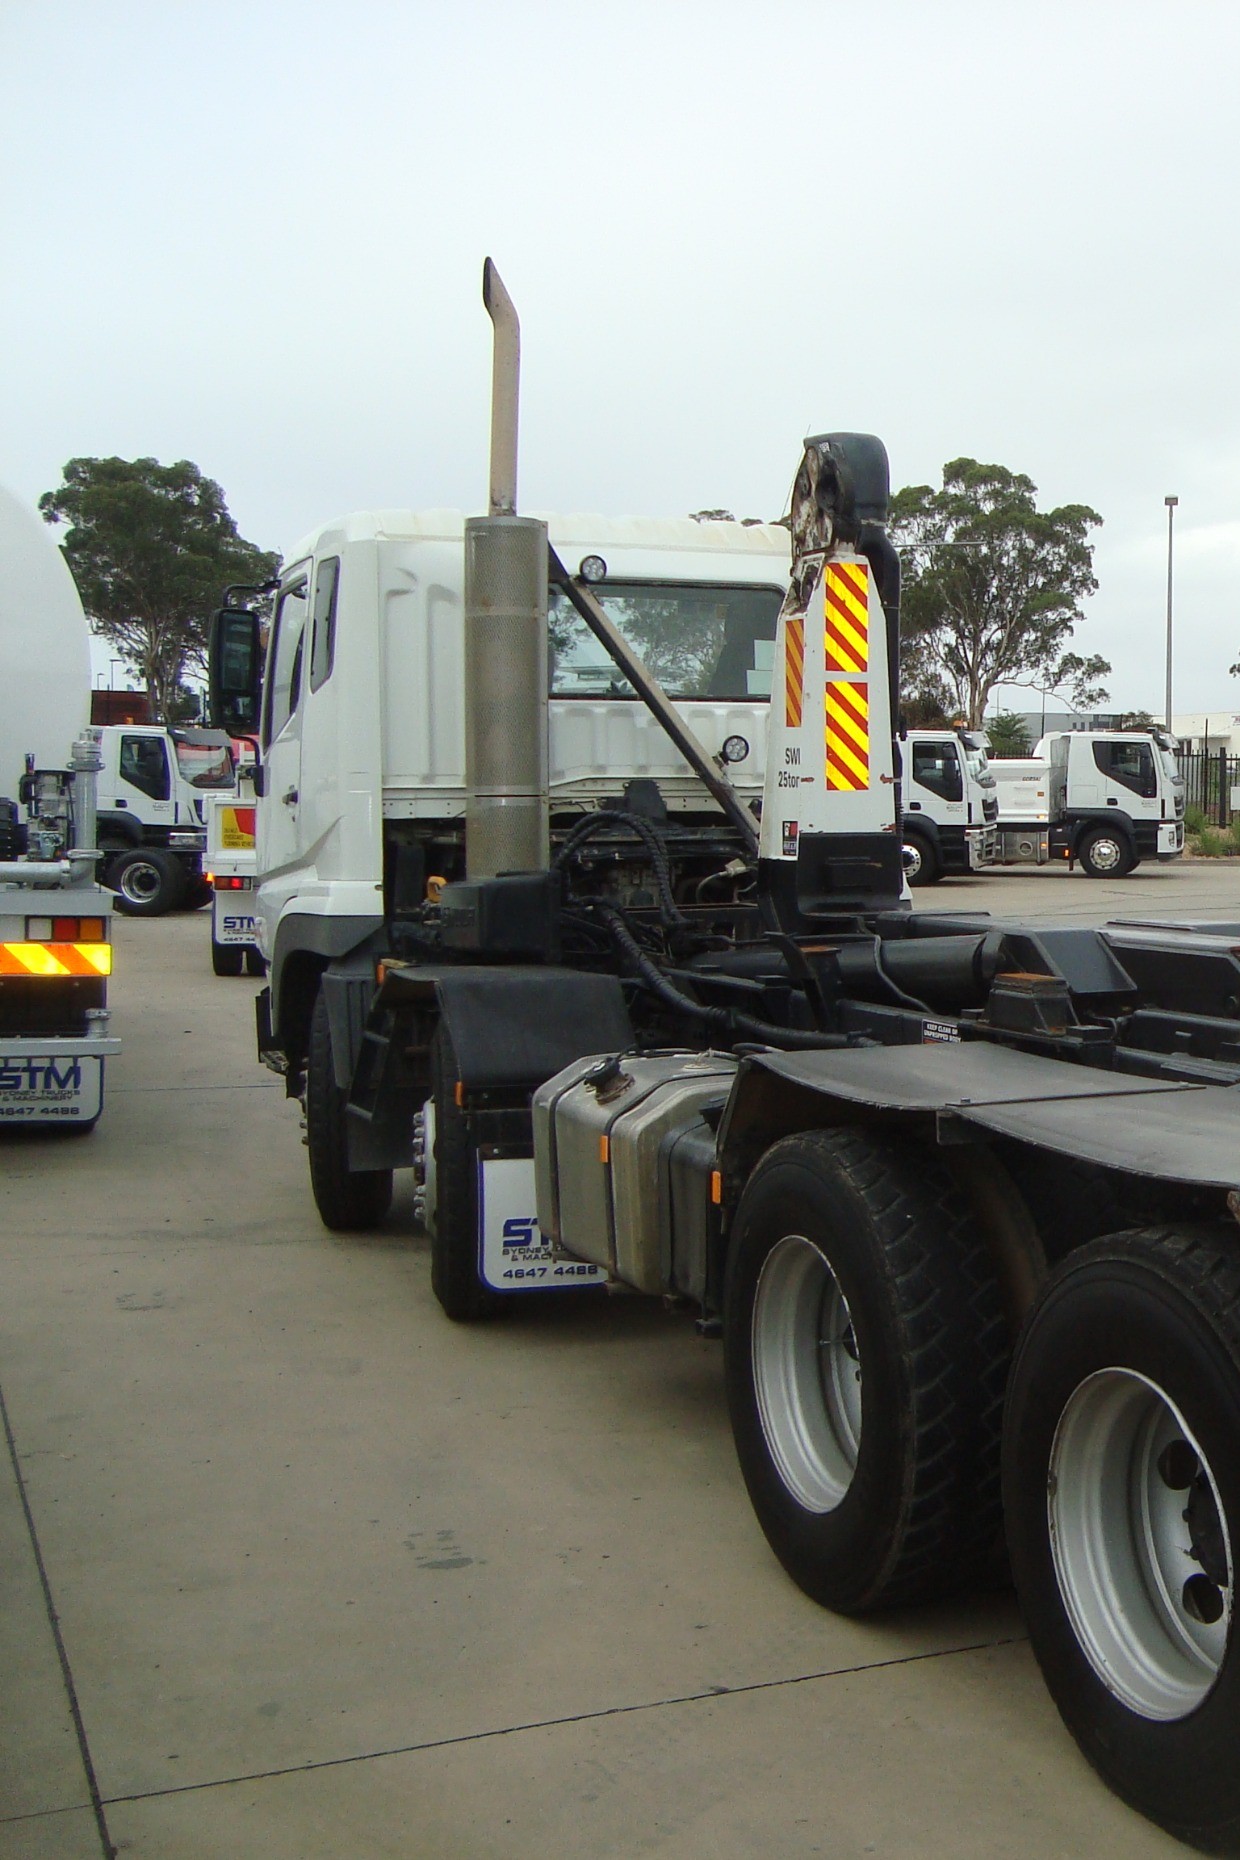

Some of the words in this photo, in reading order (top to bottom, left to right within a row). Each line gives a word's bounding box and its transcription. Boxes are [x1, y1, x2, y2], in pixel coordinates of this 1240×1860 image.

[0, 1066, 82, 1089] STM
[40, 1107, 80, 1115] 4488
[502, 1247, 549, 1255] SYDNEY
[503, 1267, 548, 1279] 4647
[553, 1264, 599, 1276] 4488
